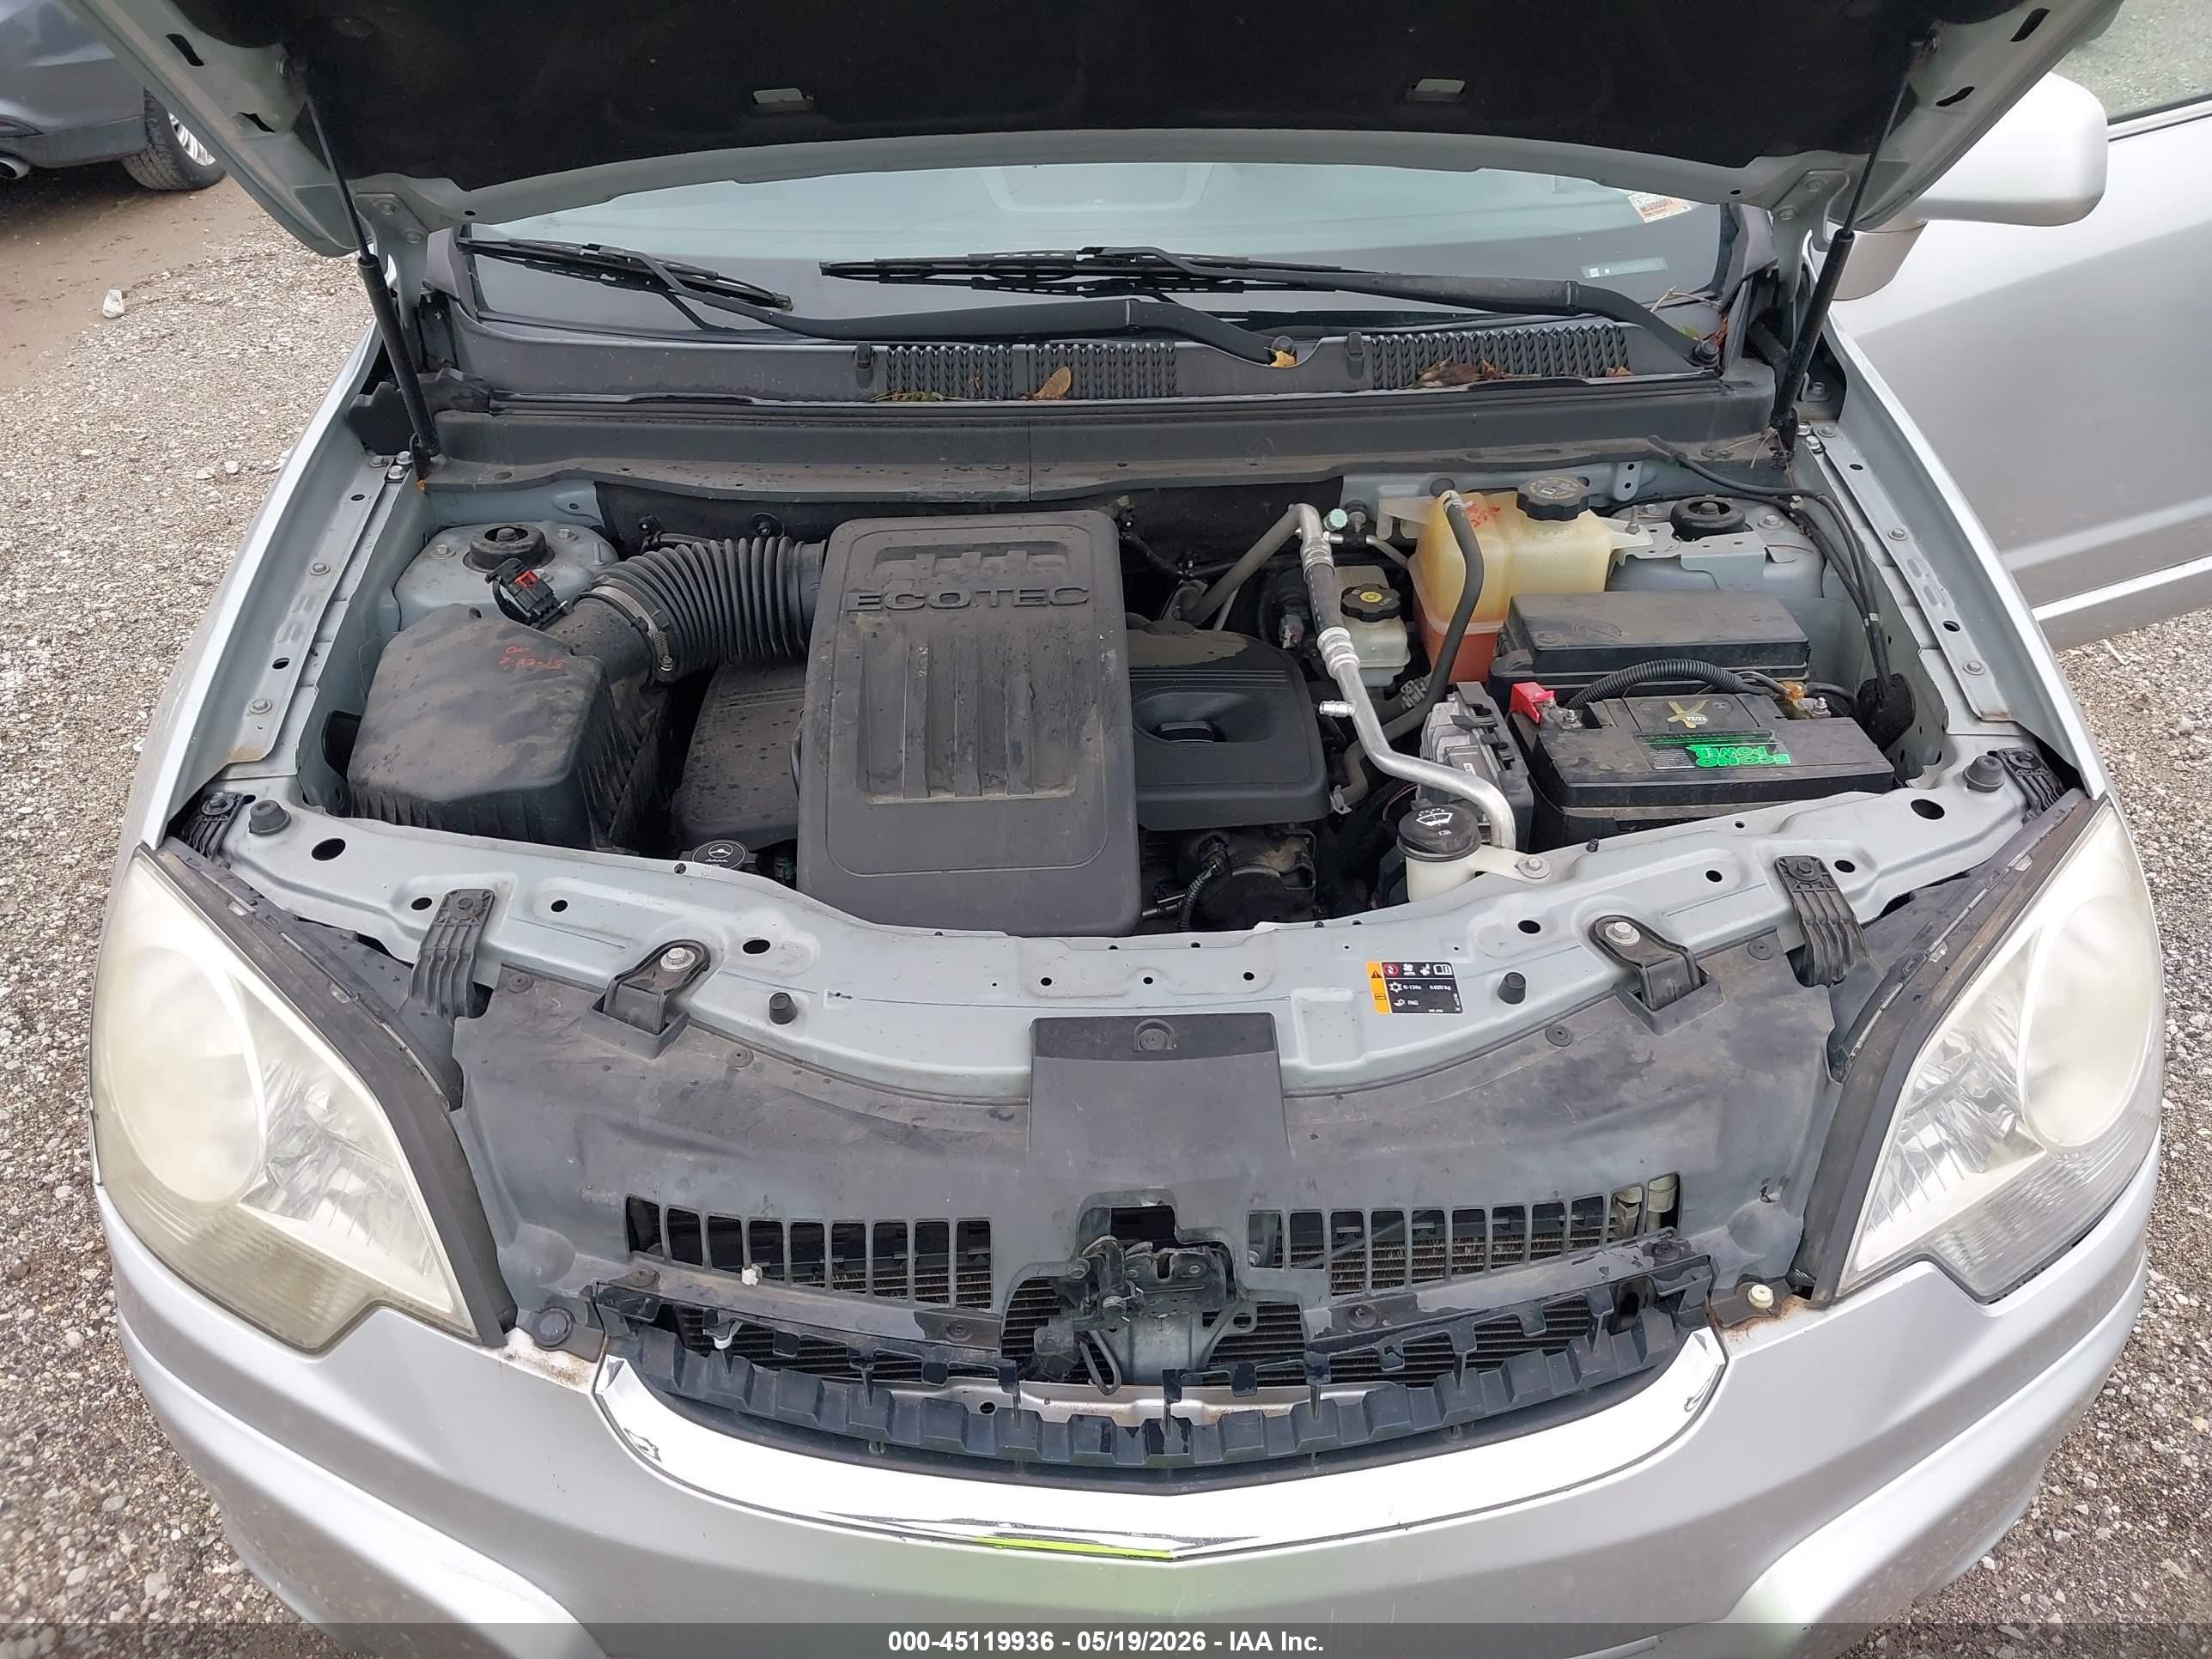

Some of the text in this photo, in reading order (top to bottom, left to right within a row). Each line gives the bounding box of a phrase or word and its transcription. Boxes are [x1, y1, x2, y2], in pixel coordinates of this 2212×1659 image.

[847, 587, 1090, 613] ECOTEC
[1689, 744, 1769, 757] POWER
[1694, 753, 1792, 768] ECONO
